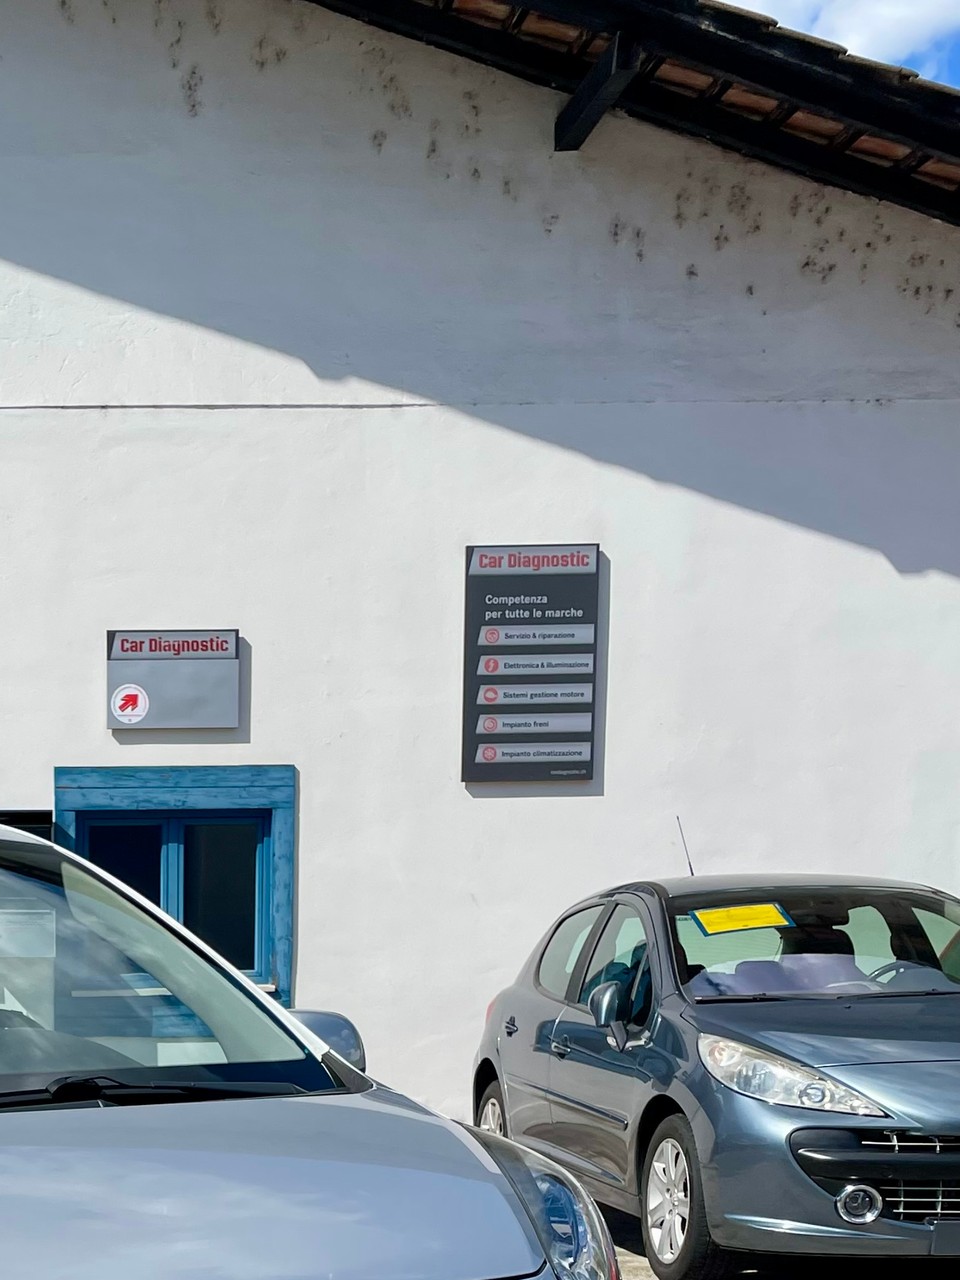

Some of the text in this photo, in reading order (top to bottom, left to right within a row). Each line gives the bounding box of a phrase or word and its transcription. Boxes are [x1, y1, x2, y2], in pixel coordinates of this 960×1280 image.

[478, 551, 590, 570] Car Diagnostic
[485, 594, 548, 606] Competenza
[485, 607, 584, 621] per tutte le marche
[504, 632, 531, 640] Servizio
[538, 632, 576, 640] riparazione
[120, 636, 229, 656] Car Diagnostic
[502, 691, 528, 699] Sistemi
[529, 691, 558, 700] gestione
[502, 720, 549, 729] Impianto freni
[501, 751, 531, 759] Impianto
